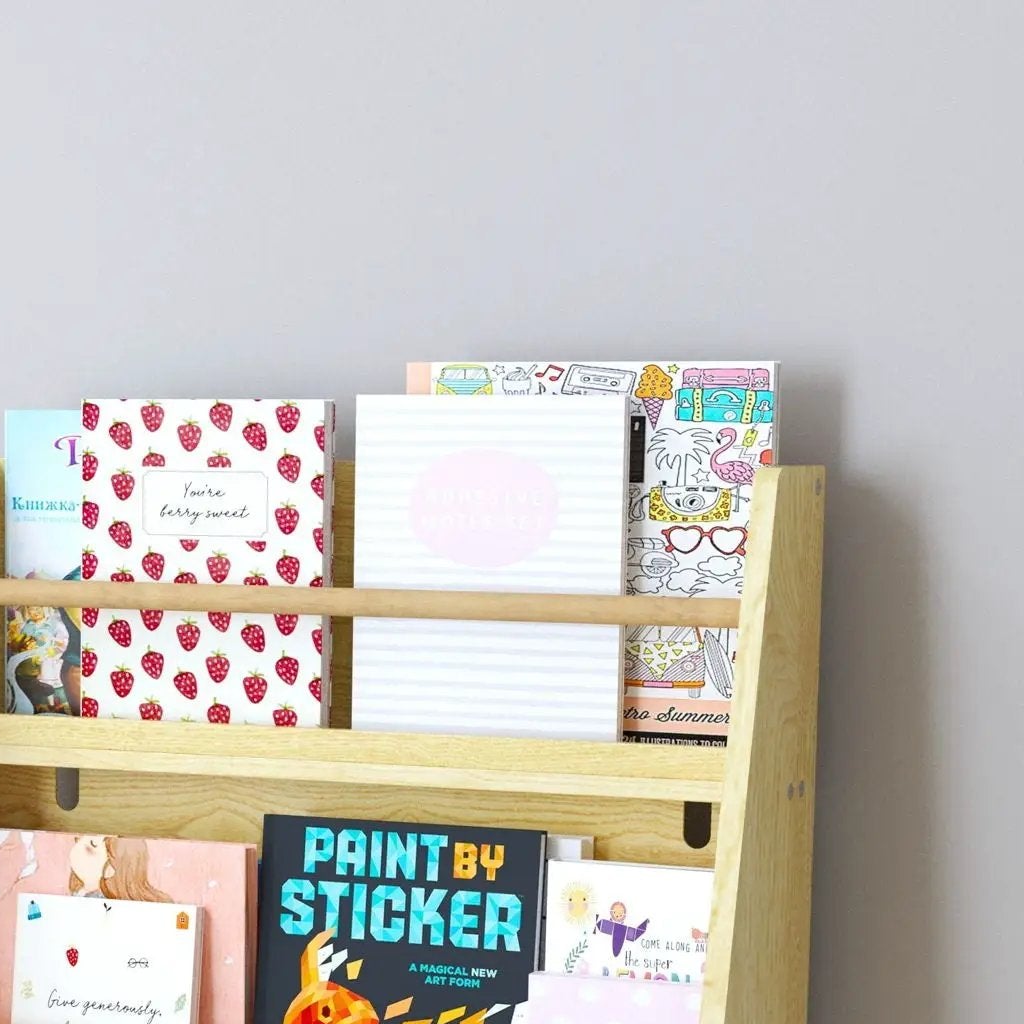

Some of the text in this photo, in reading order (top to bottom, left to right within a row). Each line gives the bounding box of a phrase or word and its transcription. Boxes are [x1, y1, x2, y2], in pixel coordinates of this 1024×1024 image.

[184, 481, 226, 498] You're
[160, 504, 250, 525] berry sweet
[655, 706, 730, 723] Summer
[303, 827, 505, 882] PAINT BY
[280, 879, 522, 952] STICKER
[641, 939, 708, 953] COME ALONG AN
[625, 950, 640, 967] the
[643, 959, 673, 972] super
[408, 963, 497, 978] A MAGICAL NEW
[424, 976, 480, 988] ART FORM
[48, 988, 80, 1008] Give
